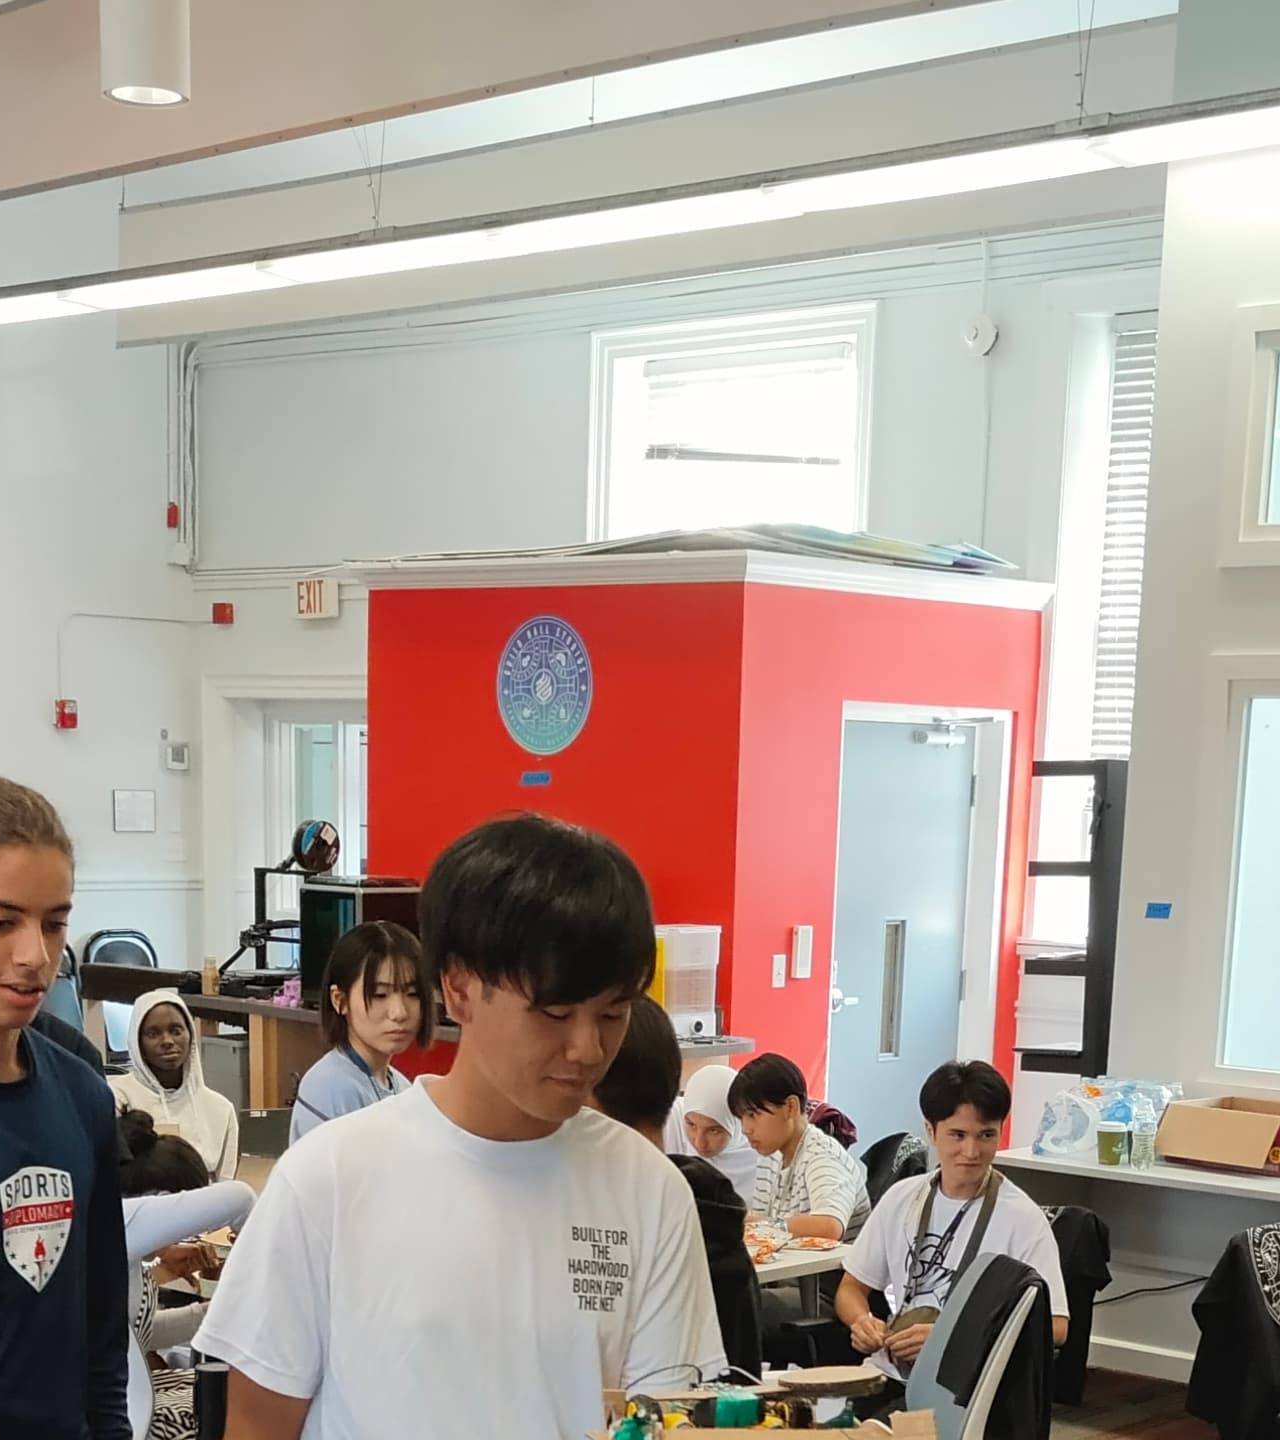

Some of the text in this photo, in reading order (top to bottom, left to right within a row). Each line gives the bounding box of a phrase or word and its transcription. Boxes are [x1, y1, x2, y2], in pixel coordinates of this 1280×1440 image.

[297, 579, 324, 614] EXIT
[4, 1173, 70, 1209] SPORTS
[571, 1226, 628, 1245] BUILT FOR
[590, 1244, 611, 1260] THE
[573, 1278, 624, 1296] BORN FOR
[578, 1294, 598, 1311] THE
